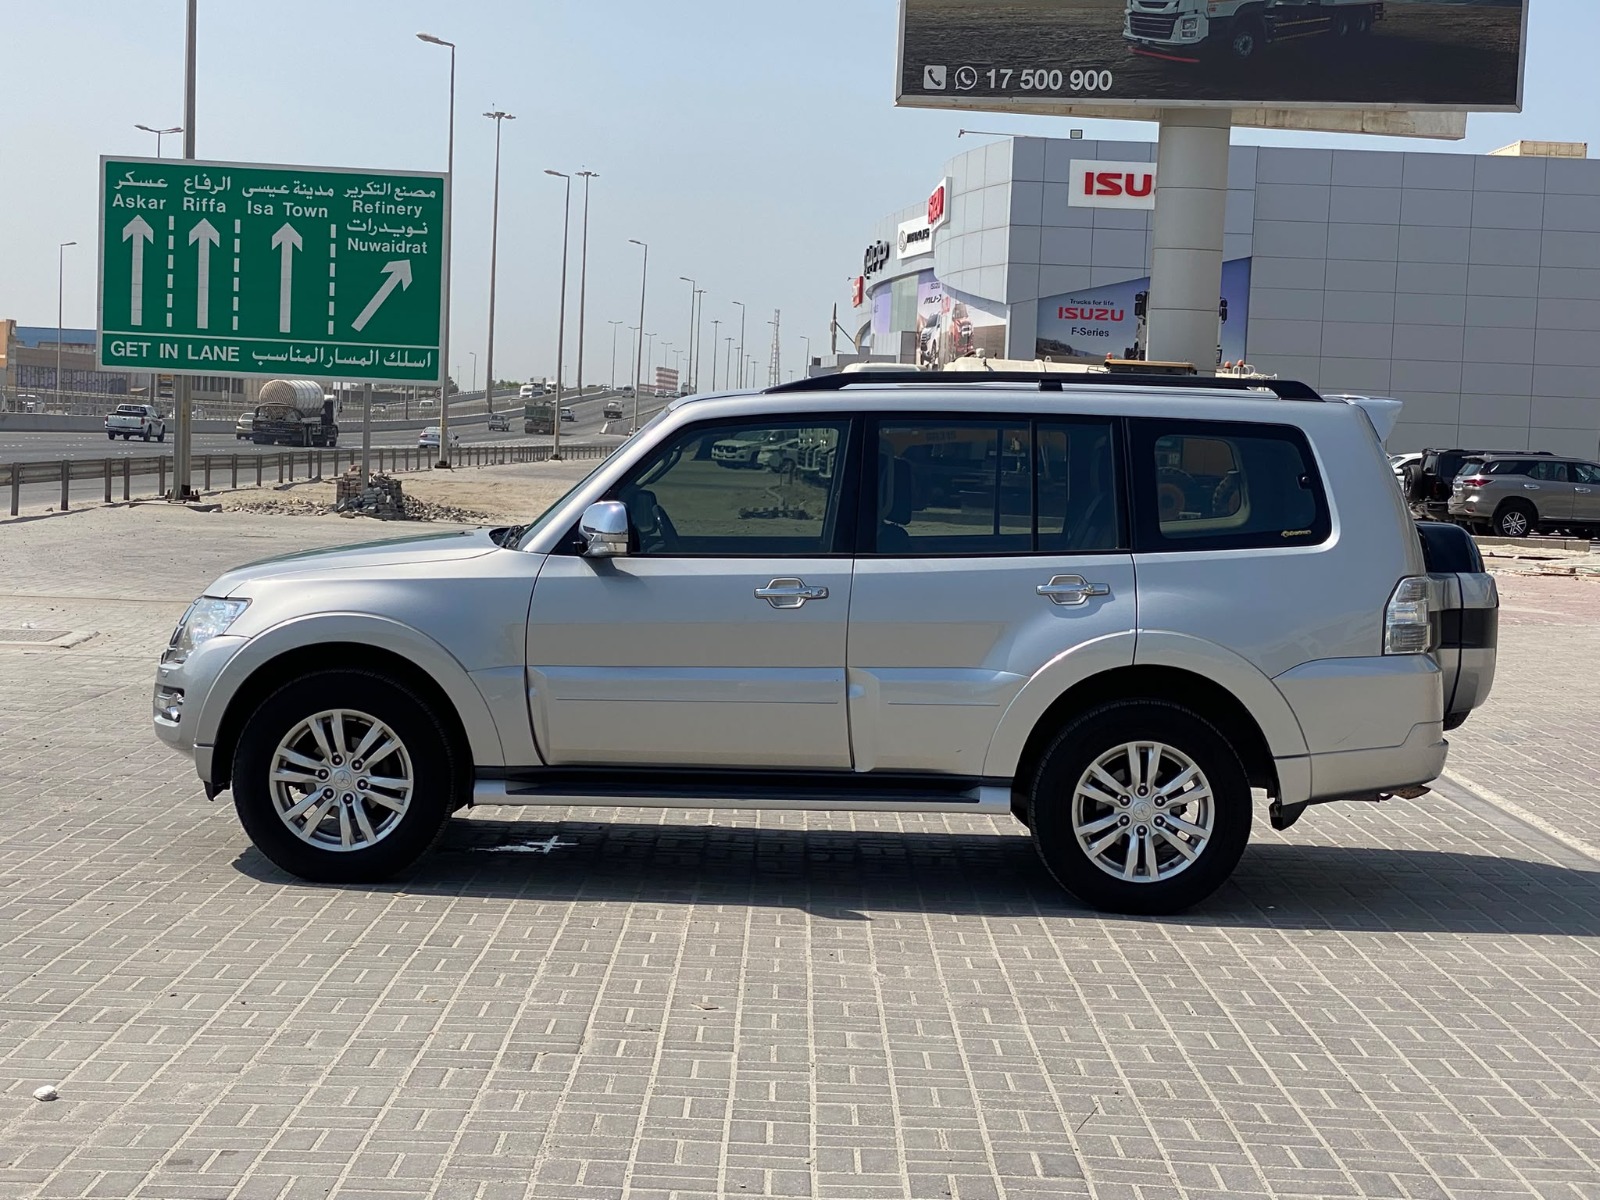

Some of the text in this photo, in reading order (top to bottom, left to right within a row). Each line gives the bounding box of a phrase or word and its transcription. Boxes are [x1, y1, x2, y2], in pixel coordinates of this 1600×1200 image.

[986, 68, 1113, 91] 17 500 900
[113, 170, 168, 190] عسكر
[184, 173, 231, 194] الرفاع
[242, 180, 334, 199] مدينة عيسى
[1084, 171, 1156, 197] ISU
[343, 181, 436, 201] مصنع التكرير
[112, 193, 167, 210] Askar
[183, 196, 226, 213] Riffa
[247, 200, 328, 218] Isa Town
[352, 200, 422, 218] Refinery
[346, 218, 428, 237] نويدرات
[347, 238, 428, 254] Nuwaidrat
[1058, 306, 1124, 321] ISUZU
[1071, 327, 1109, 337] F-Series
[110, 340, 240, 362] GET IN LANE
[252, 345, 432, 368] اسلك المسار المناسب
